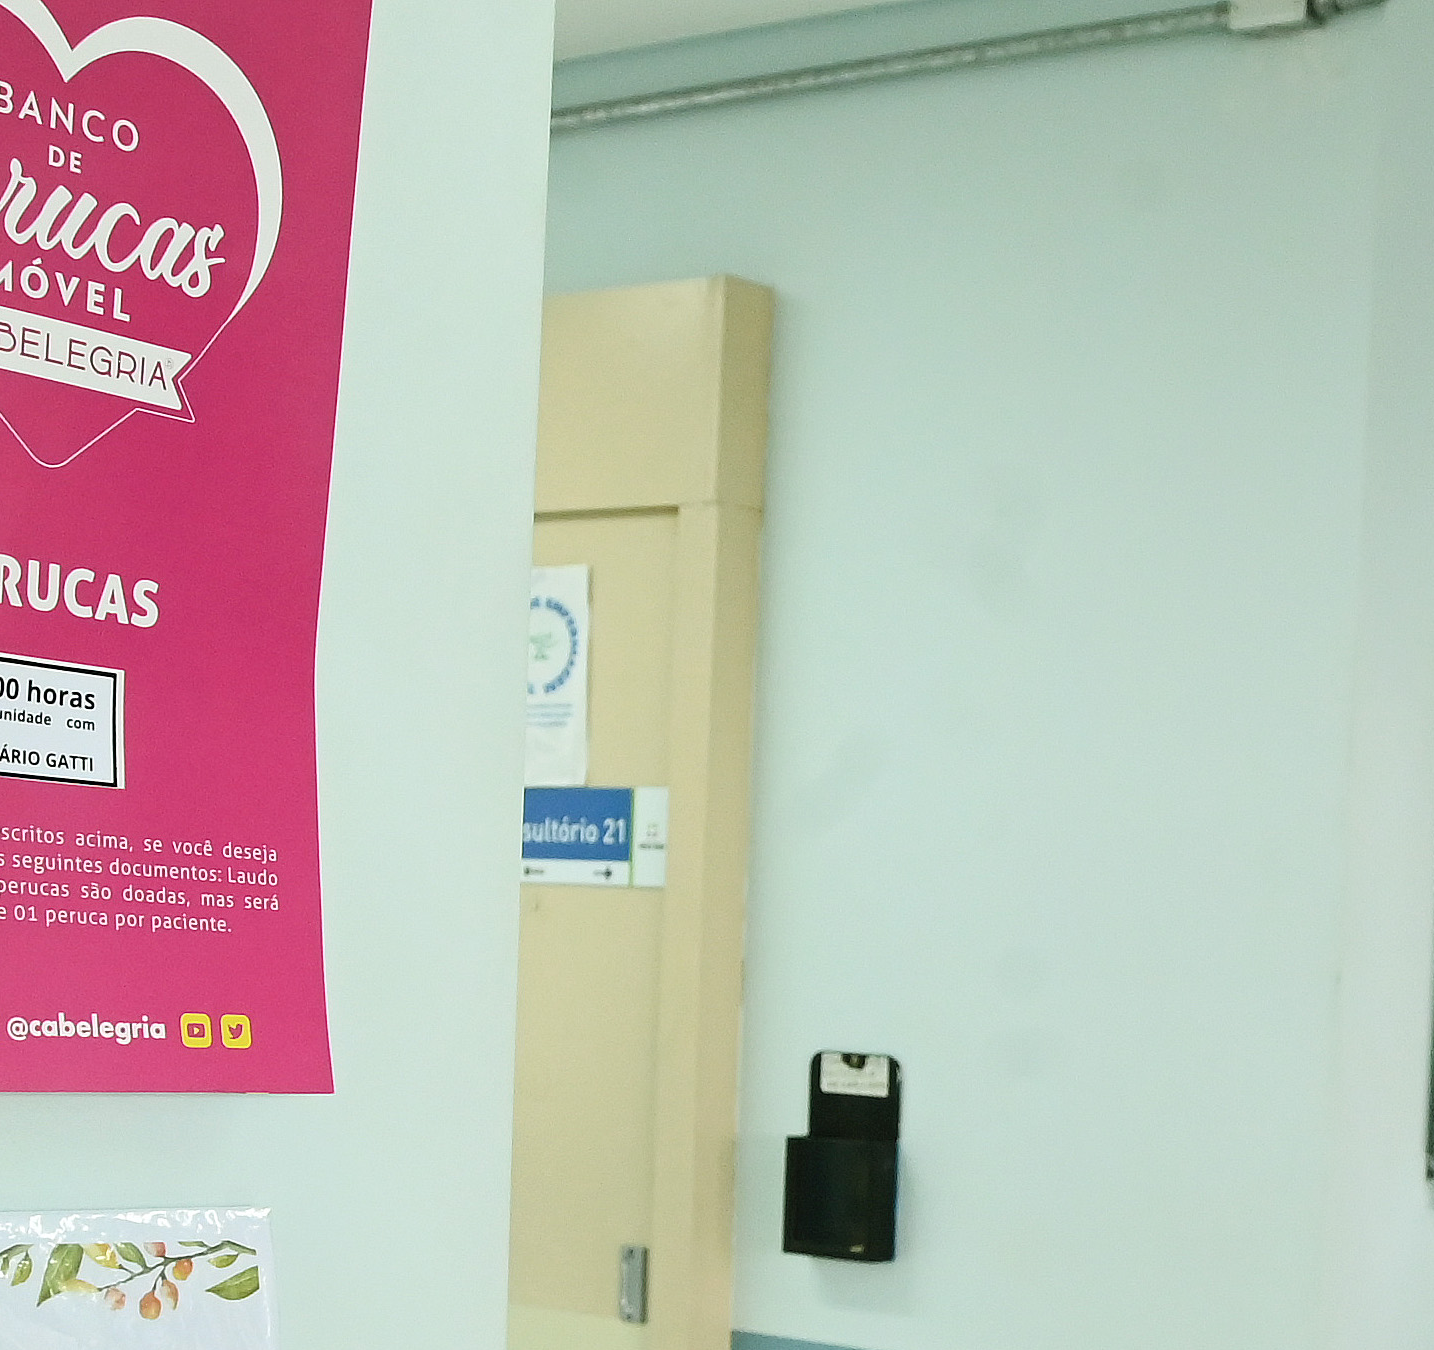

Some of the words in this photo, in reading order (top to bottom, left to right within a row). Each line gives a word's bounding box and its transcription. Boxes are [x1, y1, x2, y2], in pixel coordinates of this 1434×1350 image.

[49, 145, 81, 173] DE
[28, 680, 94, 709] horas
[67, 719, 94, 730] com
[46, 753, 92, 771] GATTI
[603, 818, 626, 844] 21
[76, 831, 132, 852] acima,
[144, 839, 162, 852] se
[173, 840, 212, 856] você
[223, 842, 276, 864] deseja
[12, 854, 102, 874] seguintes
[110, 858, 221, 882] documentos:
[228, 867, 277, 886] Laudo
[81, 883, 111, 899] são
[123, 885, 189, 907] doadas,
[202, 894, 234, 907] mas
[245, 895, 278, 910] será
[15, 905, 37, 921] 01
[46, 910, 107, 927] peruca
[116, 914, 144, 930] por
[152, 914, 231, 932] paciente.
[7, 1013, 165, 1044] @cabelegria
